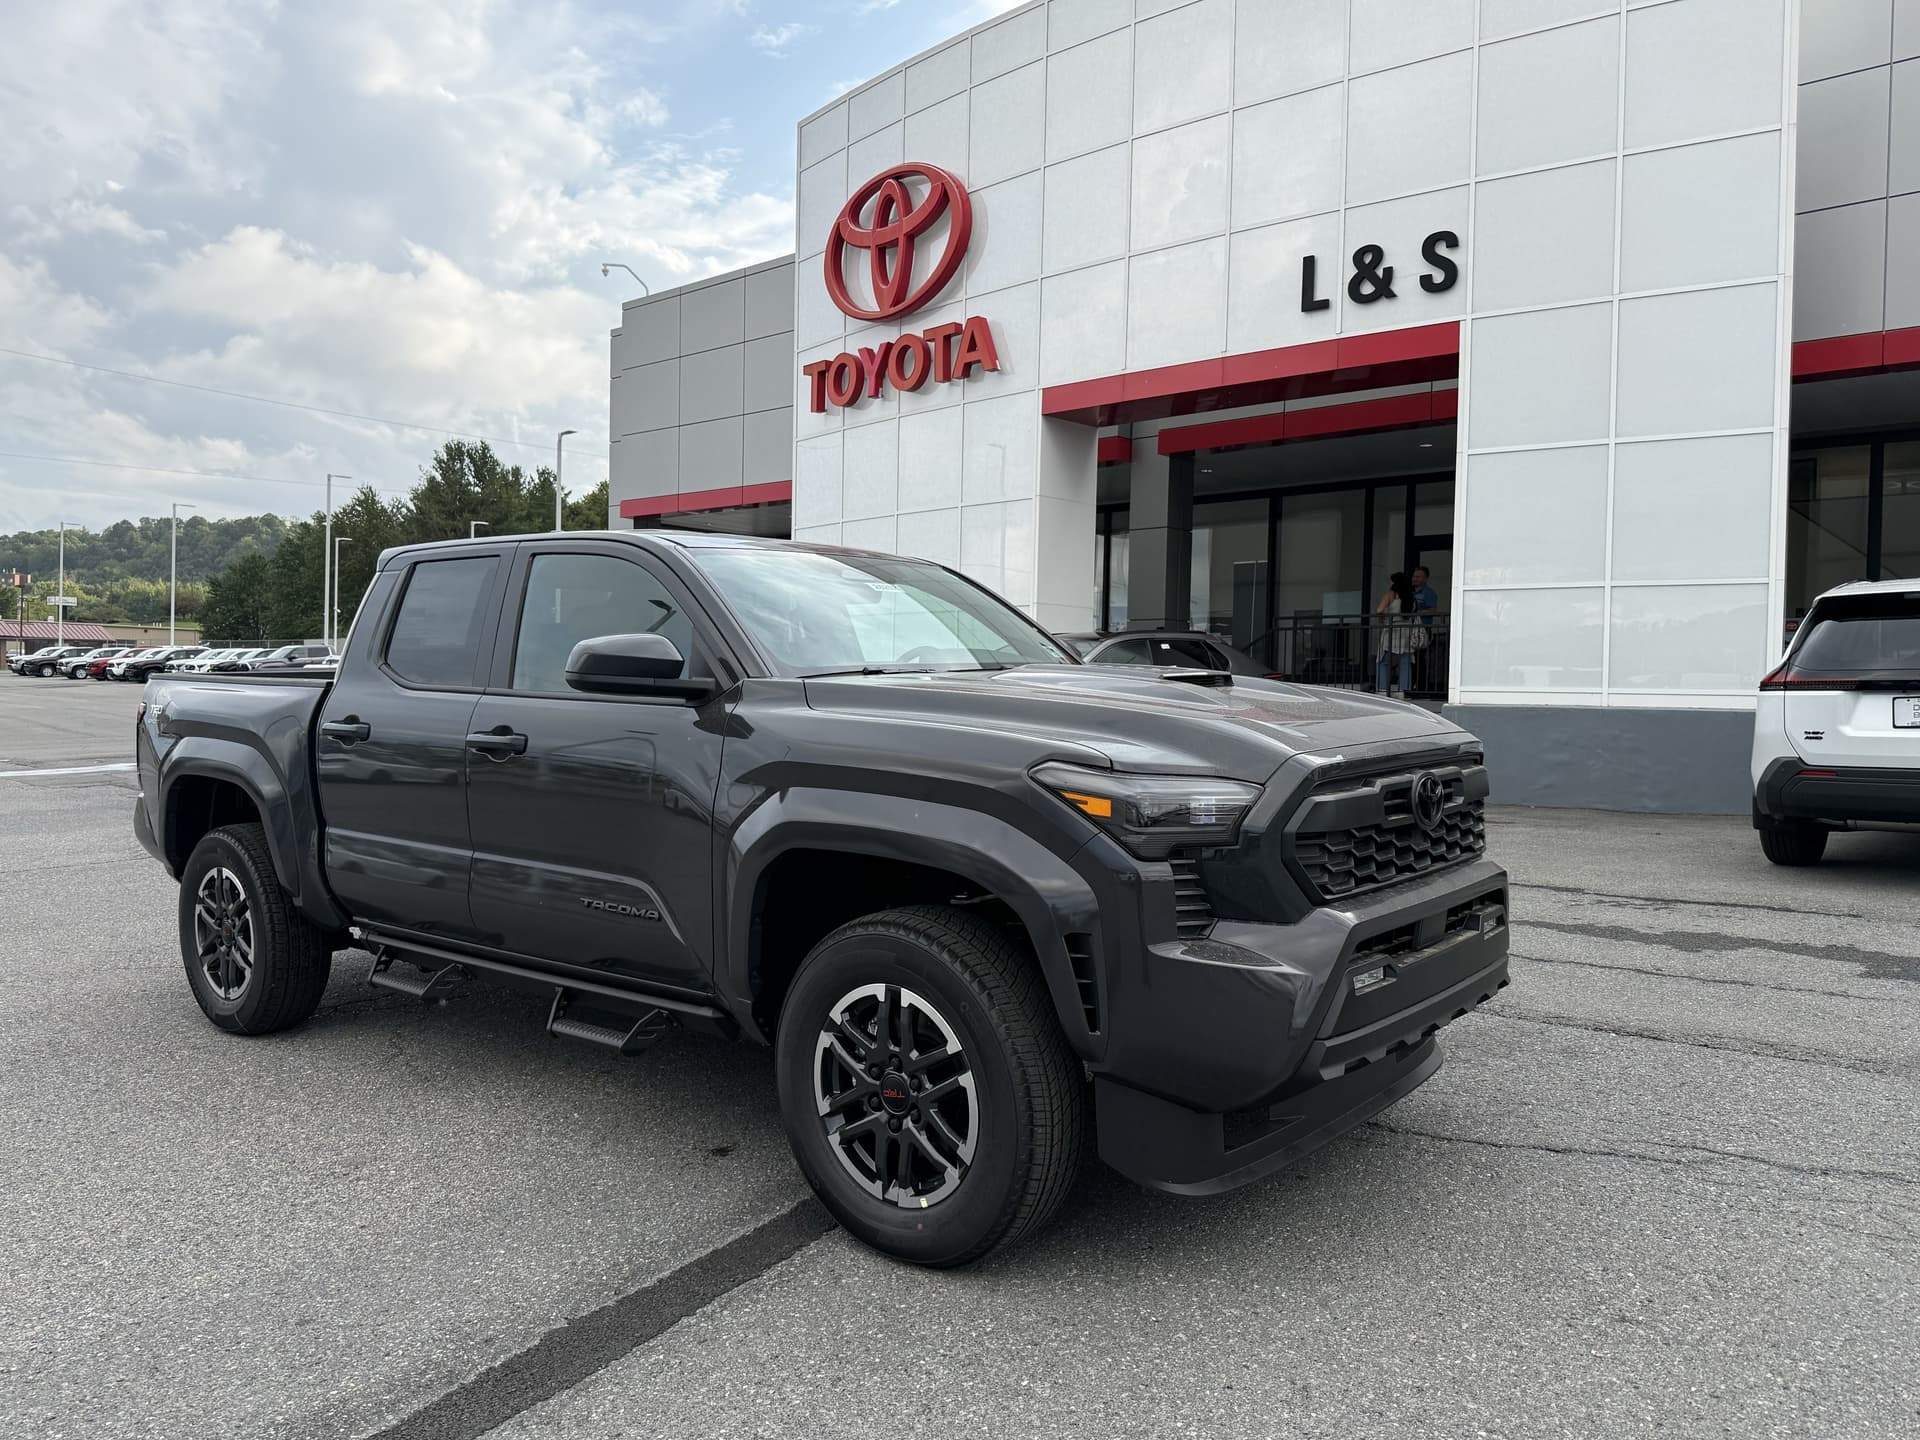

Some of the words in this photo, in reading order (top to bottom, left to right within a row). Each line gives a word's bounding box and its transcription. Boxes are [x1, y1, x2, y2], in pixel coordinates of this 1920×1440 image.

[1301, 255, 1330, 312] L
[1348, 244, 1398, 304] &
[1419, 230, 1459, 293] S
[803, 315, 1000, 413] TOYOTA
[580, 897, 661, 921] TACOMA
